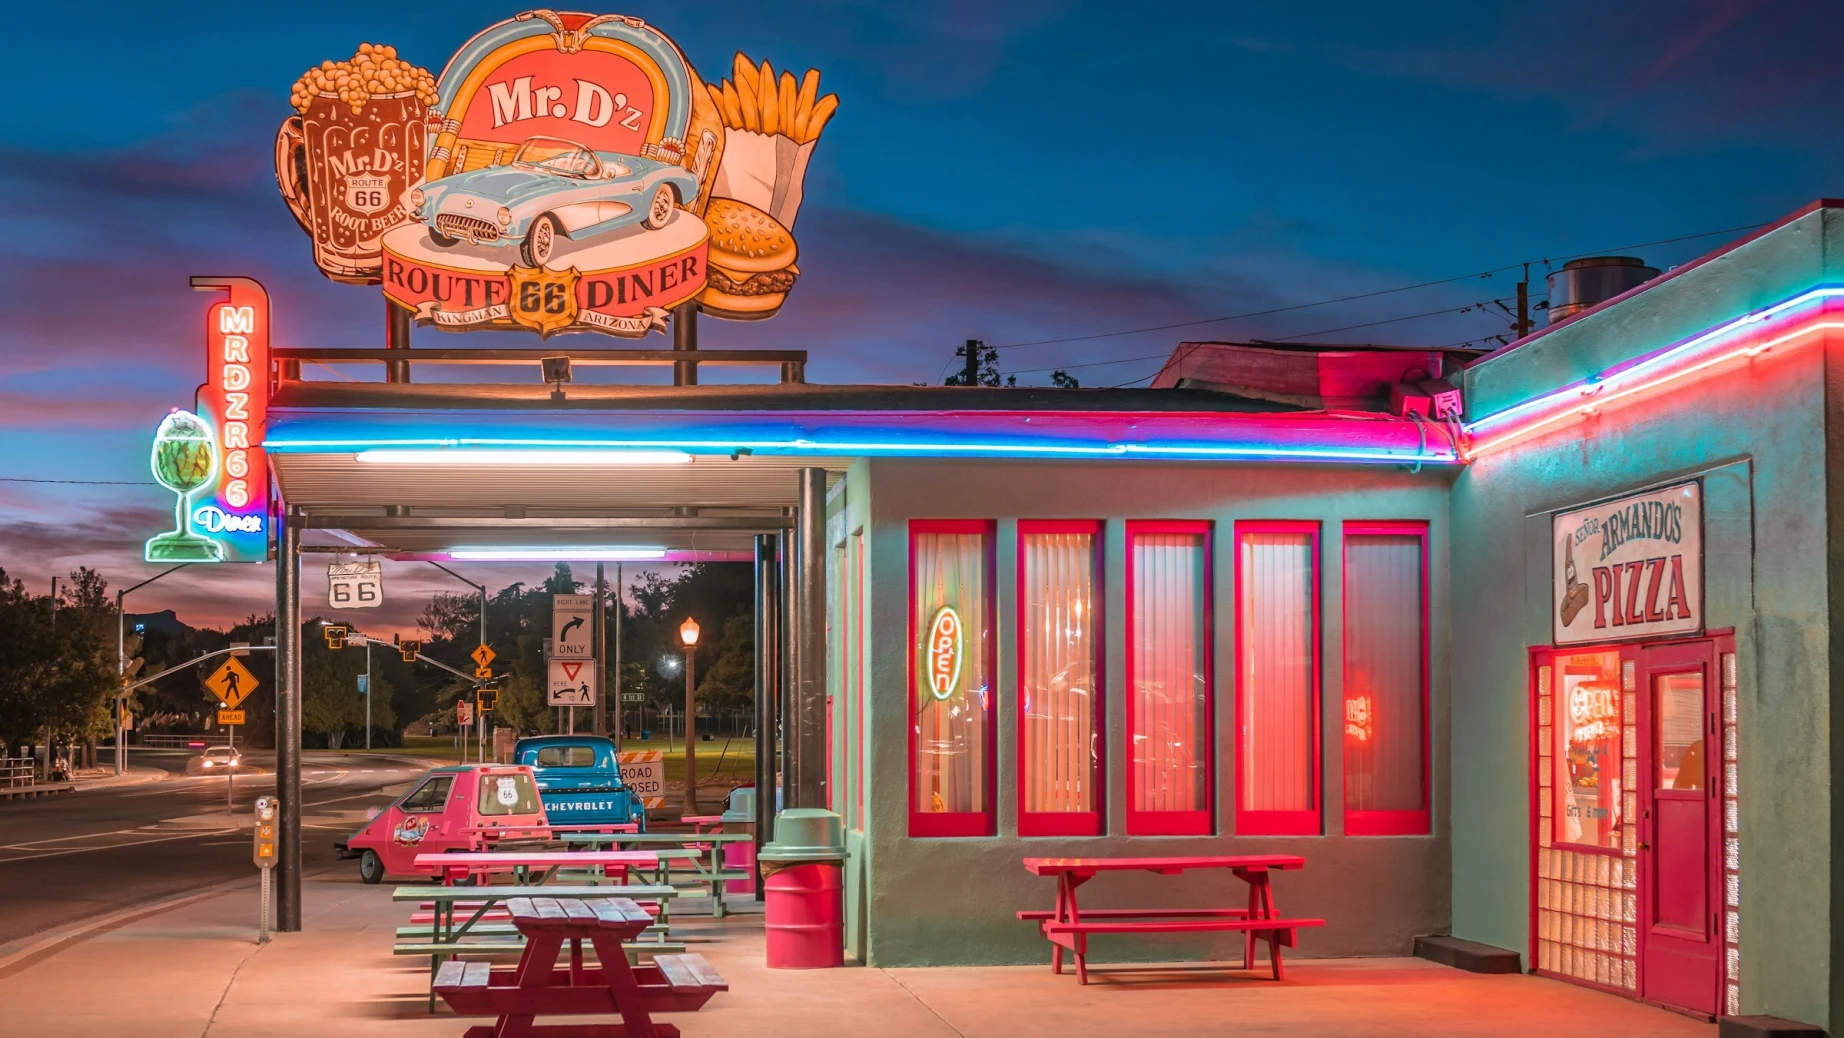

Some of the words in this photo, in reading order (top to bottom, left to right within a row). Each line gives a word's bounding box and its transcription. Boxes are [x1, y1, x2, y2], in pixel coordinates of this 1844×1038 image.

[485, 75, 567, 130] Mr.
[569, 78, 644, 132] D'z
[328, 150, 371, 179] Mr.
[355, 191, 381, 207] 66
[331, 206, 369, 232] ROOT
[371, 204, 408, 232] BEER
[388, 257, 507, 308] ROUTE
[520, 281, 566, 314] 66
[587, 256, 698, 309] DINER
[437, 306, 502, 324] KINGMAN
[584, 312, 647, 330] ARIZONA
[193, 506, 262, 533] Diner
[1575, 518, 1601, 547] SEÑOR
[1600, 500, 1682, 562] ARMANDO'S
[333, 582, 376, 602] 66
[1592, 554, 1691, 629] PIZZA
[559, 645, 585, 654] ONLY
[936, 616, 955, 691] OPEN
[621, 767, 652, 779] ROAD
[503, 790, 512, 799] 66
[630, 781, 660, 793] OSED
[545, 801, 613, 811] CHEVROLET
